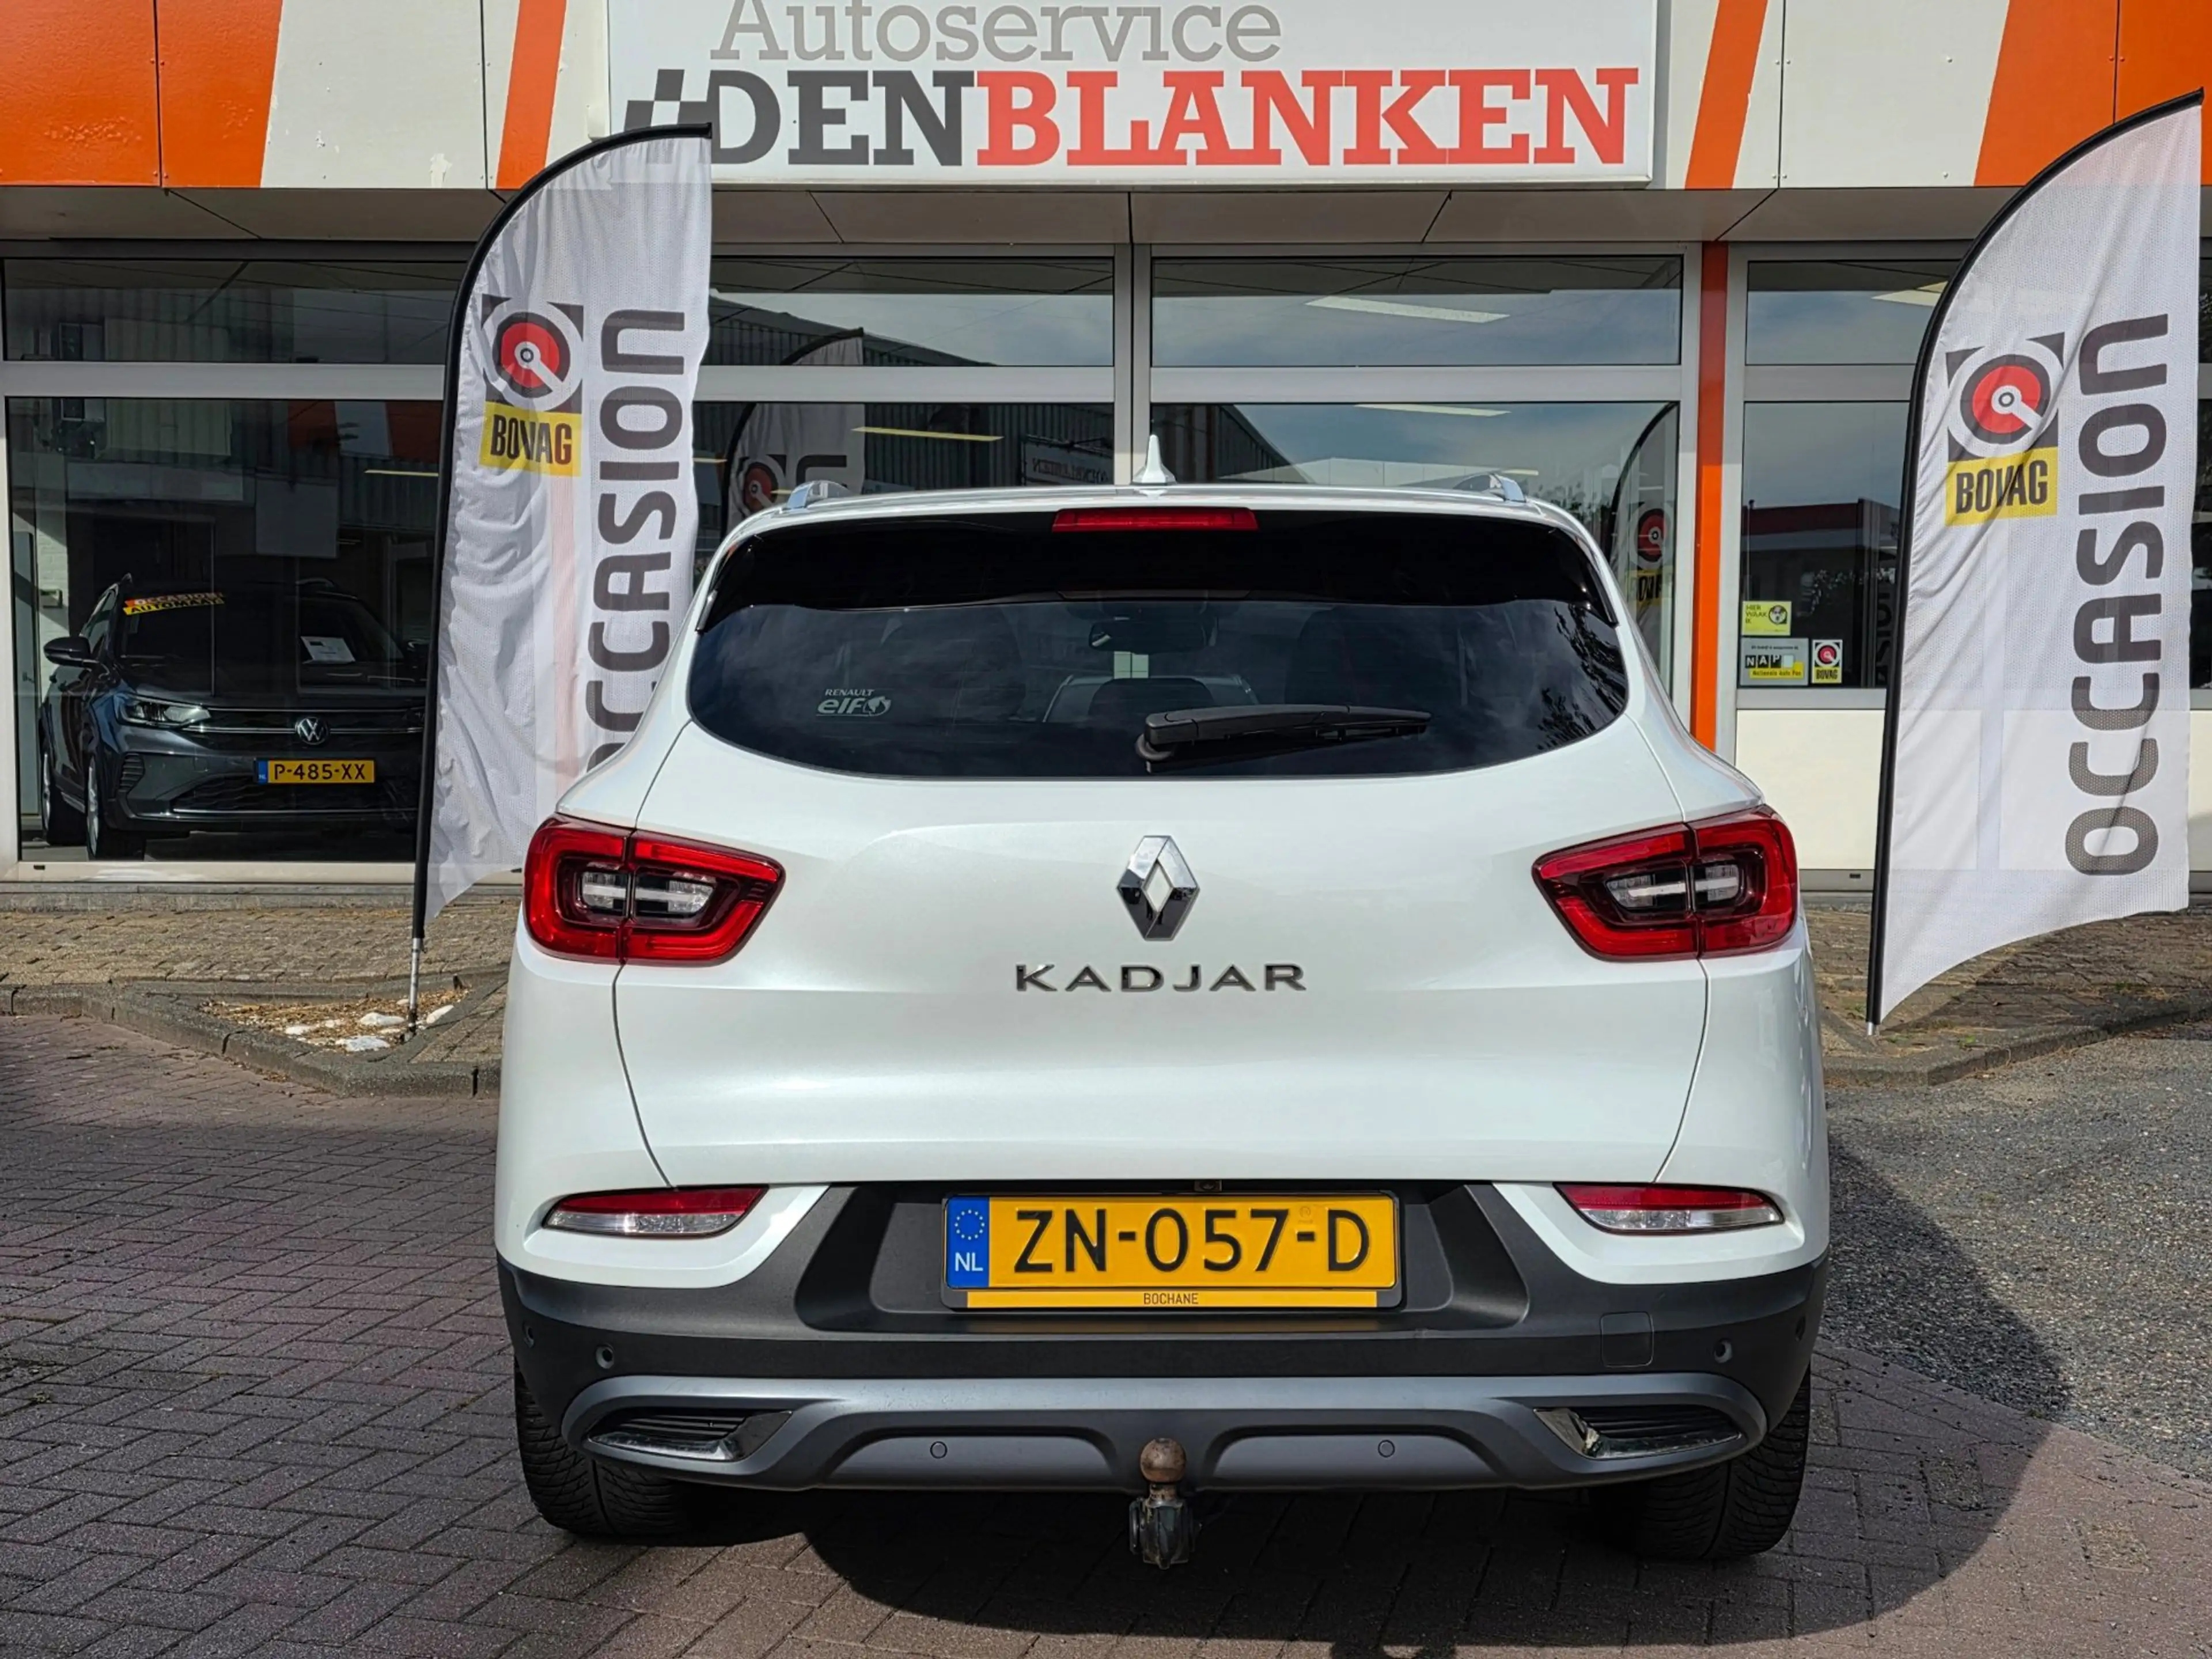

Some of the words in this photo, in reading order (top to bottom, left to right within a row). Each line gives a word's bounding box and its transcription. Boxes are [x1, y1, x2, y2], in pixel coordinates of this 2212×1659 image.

[710, 0, 1282, 62] Autoservice
[491, 414, 572, 465] BOVAG
[1956, 460, 2048, 514] BOVAG
[585, 309, 685, 772] CCASION
[2065, 313, 2168, 876] OCCASION
[1747, 654, 1780, 666] NAP
[1816, 669, 1838, 680] BOVAG
[274, 763, 365, 779] P-485-XX
[1016, 964, 1306, 992] KADJAR
[954, 1252, 984, 1272] NL
[1014, 1208, 1370, 1272] ZN-057-D
[1143, 1293, 1199, 1305] BOCHANE
